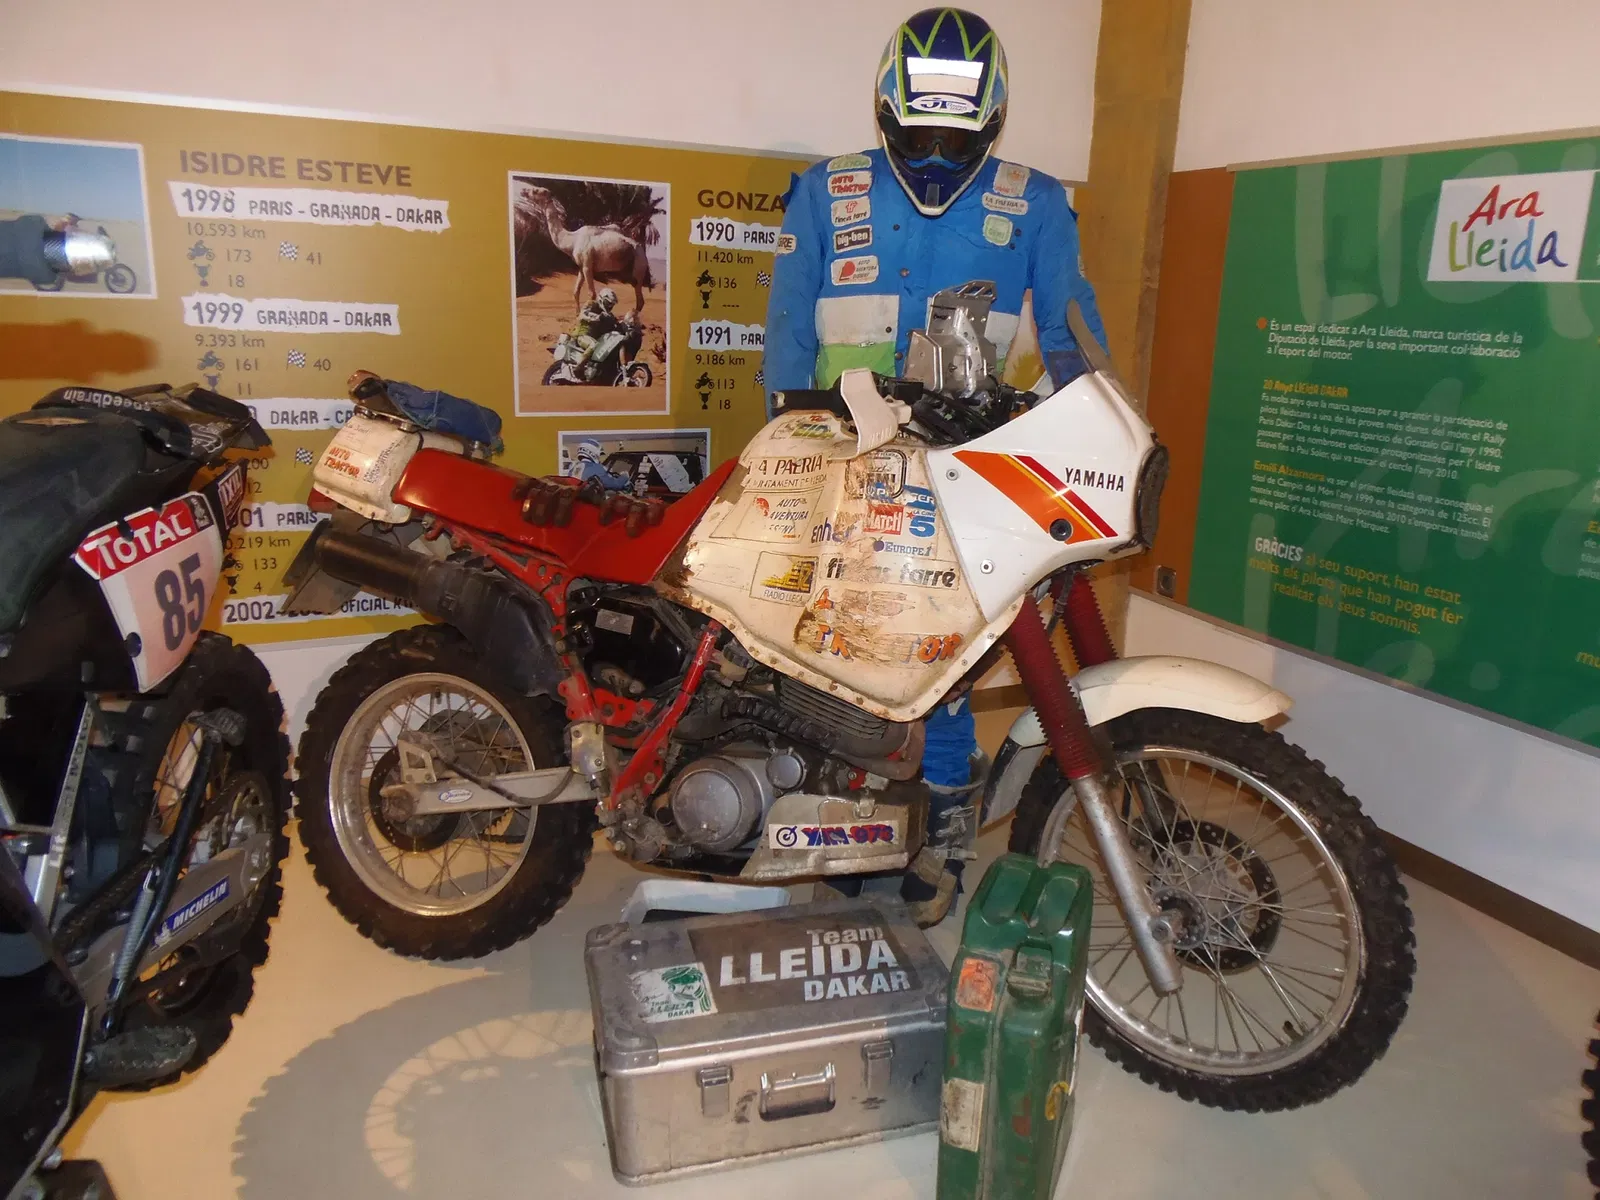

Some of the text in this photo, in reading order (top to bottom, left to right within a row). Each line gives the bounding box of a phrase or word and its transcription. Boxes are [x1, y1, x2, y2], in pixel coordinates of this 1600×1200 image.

[180, 150, 412, 187] ISIDRE ESTEVE
[831, 175, 854, 184] AUTO
[832, 184, 870, 194] TRACTOR
[182, 188, 443, 224] 1998 PARIS GRANADA DAKAR
[697, 189, 786, 214] GONZA
[1462, 184, 1544, 232] Ara
[187, 222, 266, 239] 10.593 km
[696, 222, 775, 244] 1990 PARIS
[837, 232, 868, 246] big-ben
[1449, 219, 1568, 272] Lleida
[226, 248, 322, 265] 173 41
[698, 250, 754, 264] 11.420 km
[228, 274, 245, 288] 18
[718, 278, 736, 288] 136
[192, 302, 392, 328] 1999 GRANADA DAKAR
[194, 334, 265, 348] 9.393 km
[696, 326, 731, 346] 1991
[1281, 322, 1292, 331] un
[1294, 322, 1315, 334] espai
[1318, 323, 1350, 334] dedicat
[1359, 325, 1376, 336] Ara
[1412, 330, 1444, 339] marca
[1447, 330, 1491, 342] turística
[1495, 331, 1509, 342] de
[1513, 332, 1523, 344] la
[1269, 332, 1307, 346] Diputació
[1308, 336, 1319, 345] de
[1349, 340, 1364, 350] per
[1366, 338, 1374, 349] la
[1377, 341, 1396, 350] seva
[1399, 340, 1448, 354] important
[695, 354, 745, 366] 9.186 km
[1274, 345, 1305, 358] l'esport
[1308, 348, 1321, 358] del
[1323, 350, 1352, 360] motor.
[236, 358, 332, 371] 161 40
[237, 383, 252, 396] 11
[717, 378, 735, 390] 113
[719, 400, 731, 410] 18
[270, 410, 318, 425] DAKAR
[1306, 400, 1508, 430] que la marca aposta per participació de
[1334, 414, 1343, 422] de
[1358, 419, 1384, 428] proves
[1431, 428, 1444, 436] del
[1472, 432, 1480, 441] el
[1483, 432, 1506, 446] Rally
[1312, 424, 1321, 432] de
[1330, 428, 1358, 438] primera
[1405, 436, 1438, 449] Gonzalo
[1456, 444, 1476, 456] l'any
[329, 447, 351, 460] AUTO
[324, 456, 360, 478] TRACTOR
[774, 455, 822, 475] PAERIA
[1388, 461, 1434, 478] cercle l'any
[1449, 459, 1464, 467] per
[1475, 460, 1501, 472] Isidre
[1065, 467, 1124, 492] YAMAHA
[777, 498, 800, 508] AUTO
[1484, 505, 1494, 514] el
[277, 512, 318, 526] PARIS
[1438, 510, 1448, 519] de
[909, 516, 935, 537] 5
[83, 511, 192, 570] TOTAL
[269, 536, 291, 547] km
[254, 558, 277, 570] 133
[1255, 537, 1461, 604] GRÀCIES al seu suport, han estat
[254, 582, 262, 592] 4
[764, 590, 785, 600] RADIO
[1250, 558, 1463, 624] molts els pilots que han pogut fer
[154, 552, 205, 651] 85
[341, 598, 390, 613] OFICIAL
[1273, 583, 1420, 634] realitzar els seus somnis.
[172, 882, 227, 930] MICHELIN
[806, 926, 883, 946] Team
[720, 939, 899, 987] LLEIDA
[804, 970, 910, 1001] DAKAR
[668, 1009, 694, 1018] DAKAR
